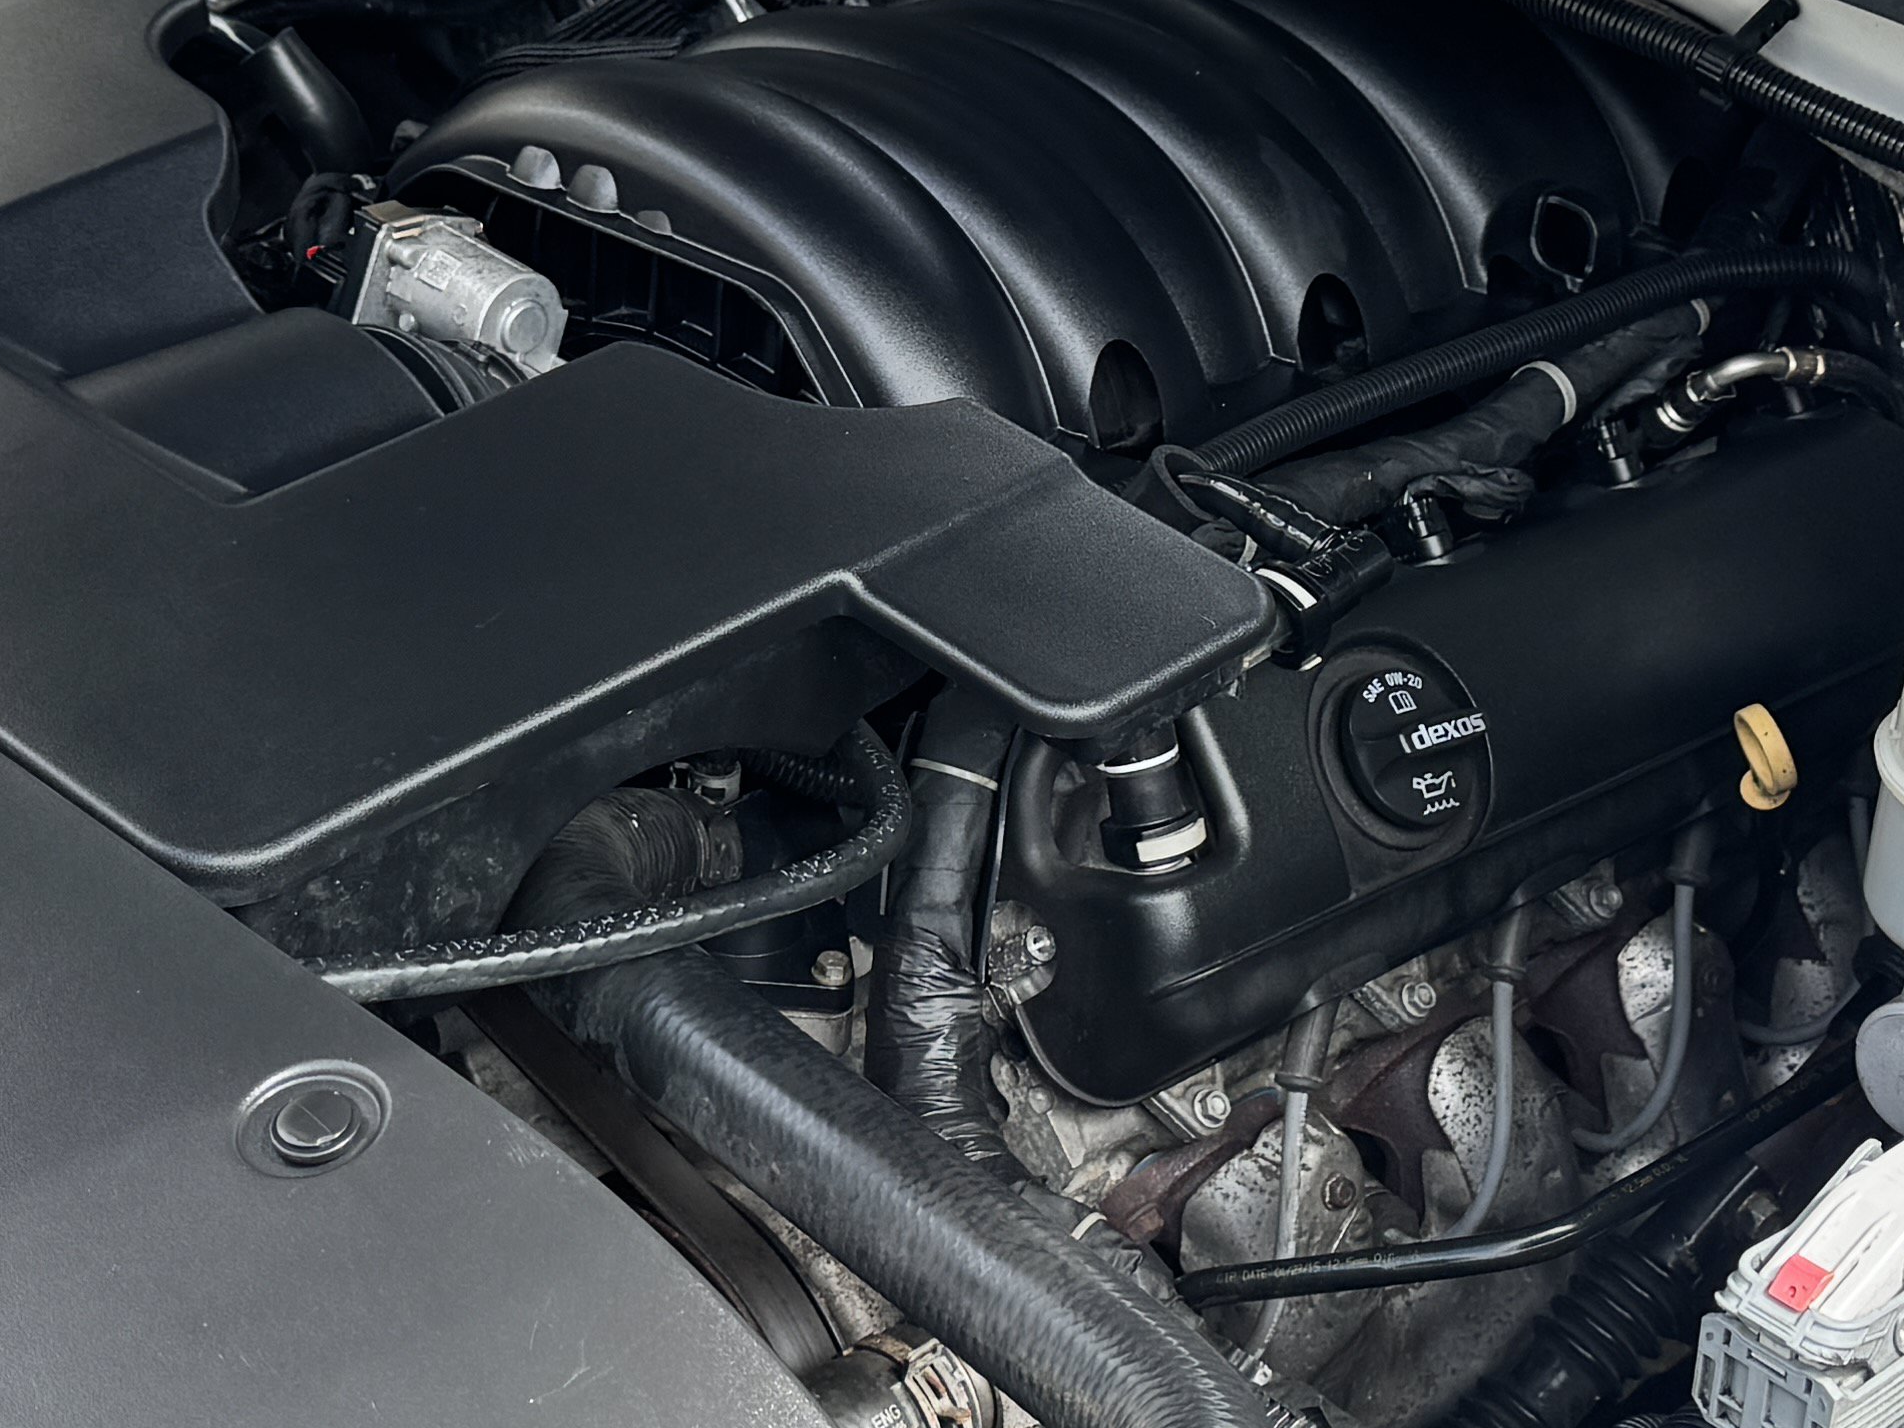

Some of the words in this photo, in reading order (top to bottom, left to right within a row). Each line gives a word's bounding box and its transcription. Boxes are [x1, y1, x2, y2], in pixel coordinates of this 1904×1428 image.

[1362, 678, 1385, 703] SAE
[1385, 672, 1423, 689] 0W-20
[1411, 713, 1486, 750] dexos
